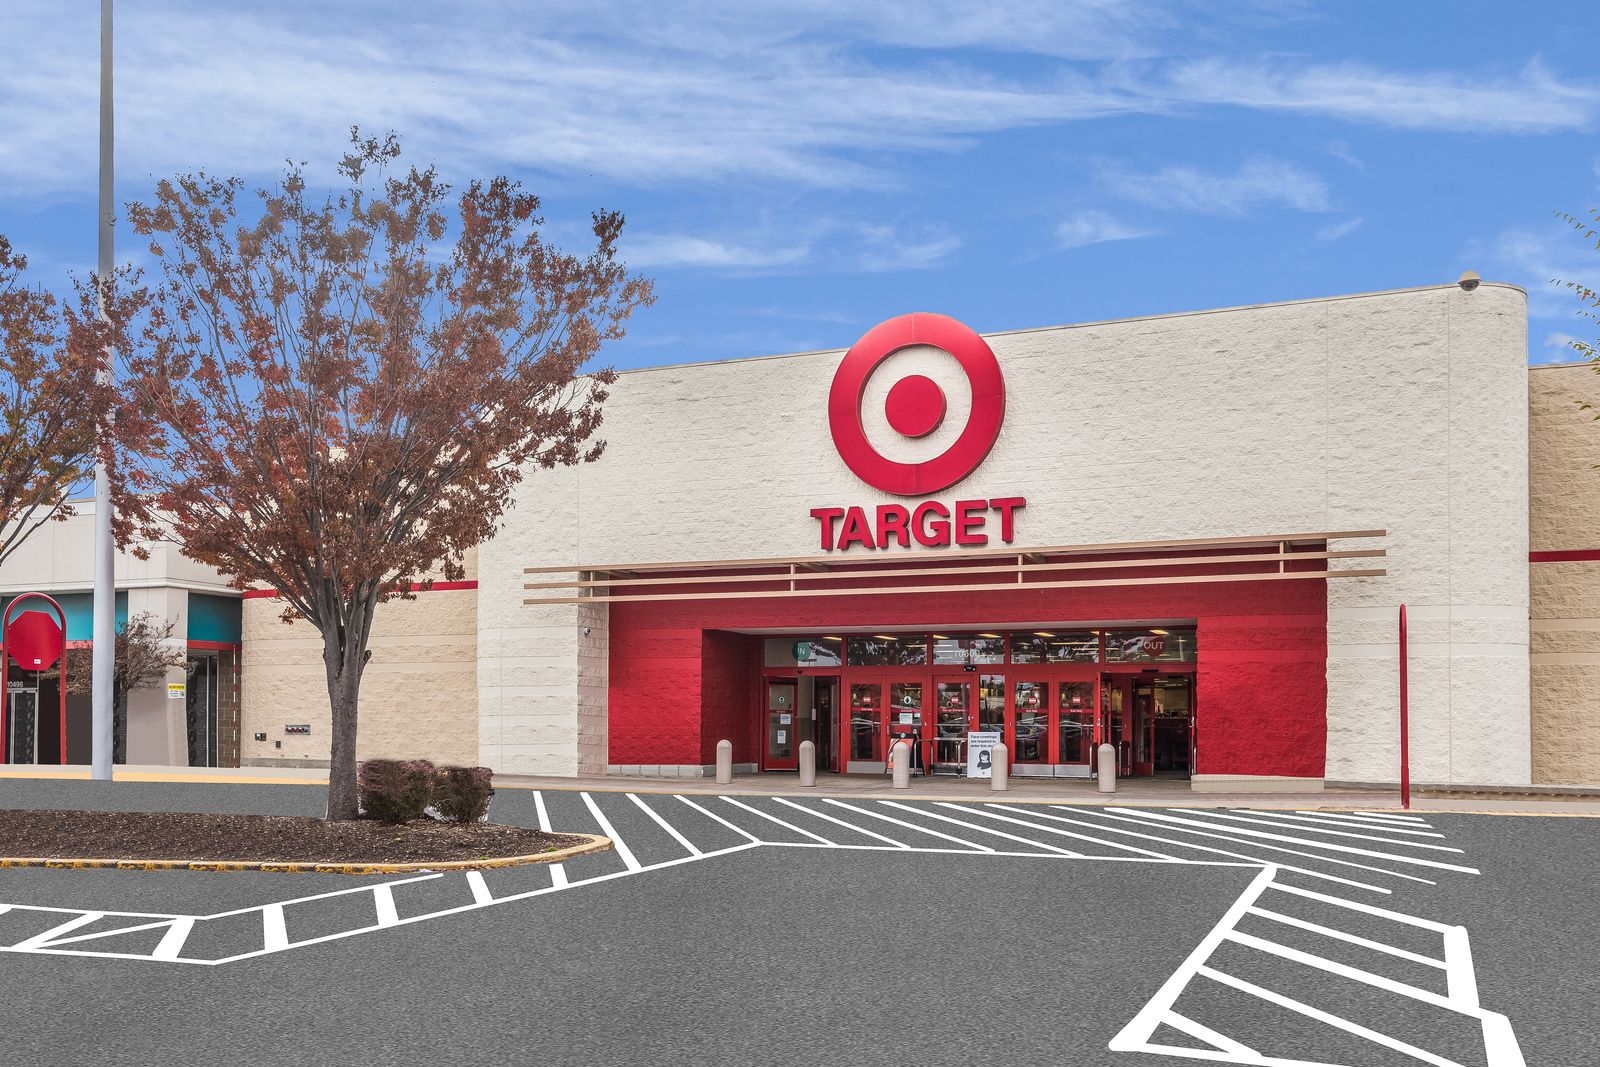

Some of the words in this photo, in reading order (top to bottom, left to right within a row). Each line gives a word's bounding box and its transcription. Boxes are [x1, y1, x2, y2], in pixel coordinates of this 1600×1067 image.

[810, 497, 1026, 550] TARGET
[1143, 641, 1165, 650] OUT
[797, 647, 806, 655] IN
[7, 680, 24, 688] 10498
